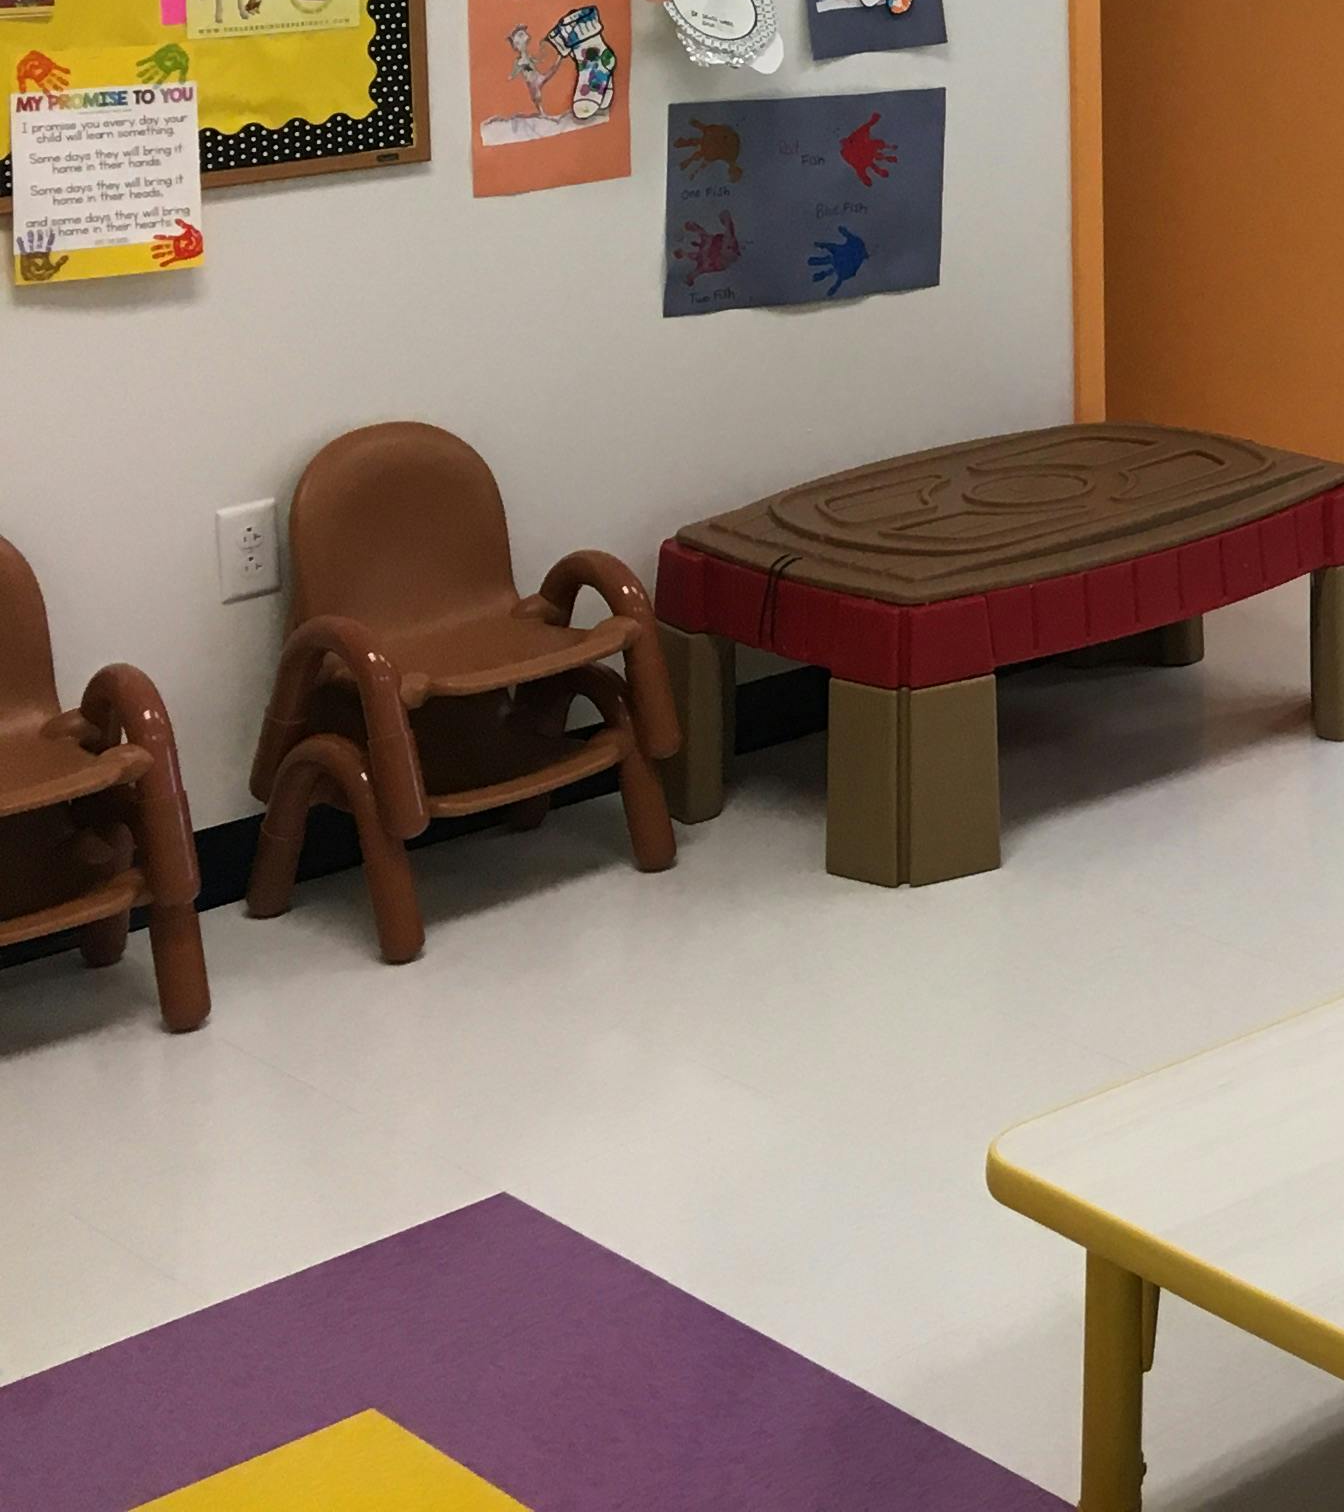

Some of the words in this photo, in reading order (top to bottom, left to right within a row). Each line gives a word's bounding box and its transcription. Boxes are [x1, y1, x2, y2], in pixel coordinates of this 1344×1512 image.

[16, 95, 43, 112] MY
[47, 90, 128, 111] PROMISE
[133, 90, 155, 104] TO
[160, 86, 194, 103] YOU
[21, 122, 27, 134] I
[31, 122, 76, 134] promise
[80, 120, 100, 131] you
[103, 117, 136, 129] every
[139, 115, 159, 126] day
[163, 114, 188, 125] your
[36, 131, 62, 144] child
[65, 130, 82, 142] will
[86, 129, 114, 139] learn
[29, 153, 61, 165] Some
[64, 151, 91, 165] days
[95, 149, 119, 161] they
[122, 147, 140, 158] will
[143, 145, 172, 157] bring
[174, 144, 183, 153] it
[52, 164, 83, 175] home
[86, 162, 95, 172] in
[99, 159, 124, 171] their
[30, 185, 63, 197] Some
[66, 183, 93, 196] days
[96, 181, 120, 193] they
[124, 177, 141, 189] will
[144, 176, 172, 189] bring
[175, 174, 184, 185] it
[52, 195, 83, 206] home
[87, 194, 96, 203] in
[100, 190, 125, 202] their
[26, 217, 48, 229] and
[51, 215, 82, 226] some
[85, 212, 111, 225] days
[115, 209, 139, 223] they
[142, 207, 159, 219] will
[162, 206, 191, 218] bring
[57, 226, 89, 238] home
[93, 225, 103, 234] in
[106, 221, 132, 233] their
[689, 292, 710, 305] Two
